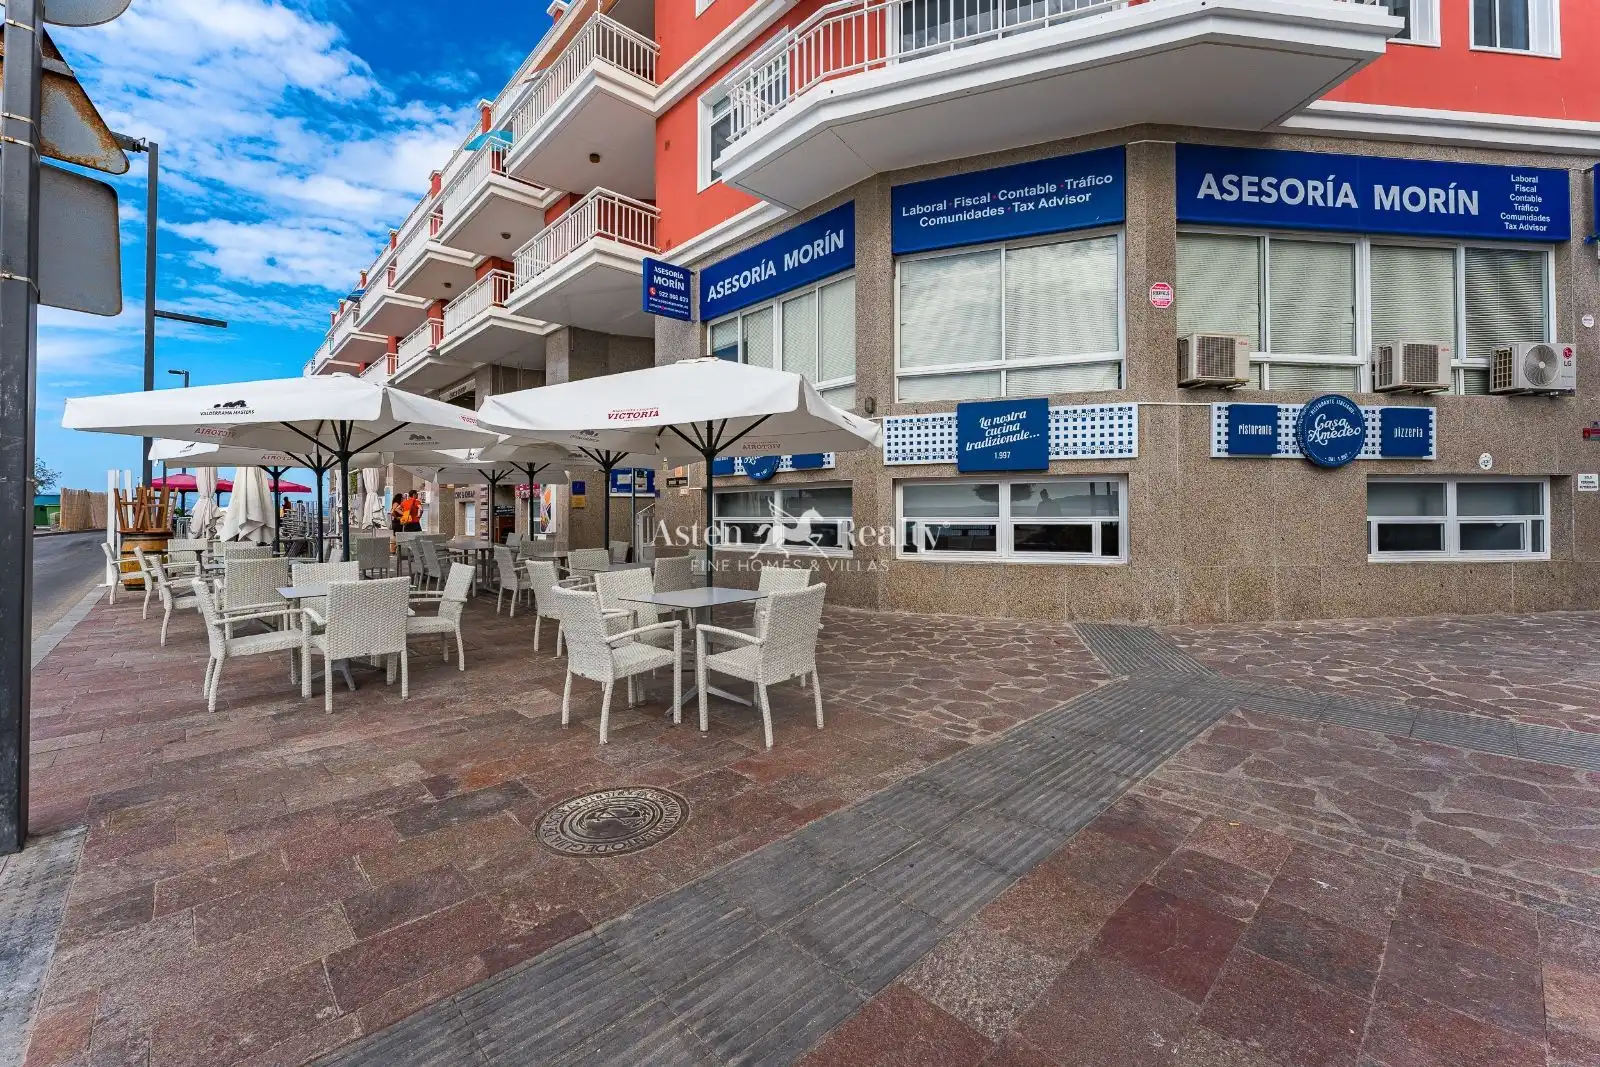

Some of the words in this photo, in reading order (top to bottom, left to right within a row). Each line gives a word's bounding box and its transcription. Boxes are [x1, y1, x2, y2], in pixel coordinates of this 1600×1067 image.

[1511, 174, 1539, 183] Laboral
[902, 200, 947, 217] Laboral
[954, 192, 991, 208] Fiscal
[998, 182, 1057, 201] Contable
[1064, 174, 1113, 190] Tráfico
[1196, 172, 1358, 209] ASESORÍA
[1374, 182, 1479, 215] MORÍN
[1515, 184, 1537, 193] Fiscal
[1509, 193, 1543, 203] Contable
[919, 206, 1005, 227] Comunidades
[1012, 201, 1035, 213] Tax
[1038, 192, 1092, 208] Advisor
[1513, 203, 1539, 212] Tráfico
[1500, 212, 1551, 222] Comunidades
[1504, 222, 1517, 230] Tax
[1518, 223, 1548, 231] Advisor
[654, 266, 684, 279] ASESORÍA
[707, 258, 777, 302] ASESORÍA
[784, 229, 844, 272] MORÍN
[653, 275, 685, 291] MORÍN
[607, 410, 660, 420] VICTORIA
[979, 417, 991, 429] La
[993, 410, 1027, 425] nostra
[1314, 413, 1350, 431] Casa
[985, 422, 1021, 437] cucina
[1238, 423, 1273, 436] ristorante
[1307, 425, 1361, 446] Amedeo
[1393, 428, 1424, 440] pizzeria
[965, 430, 1040, 451] tradizionale...
